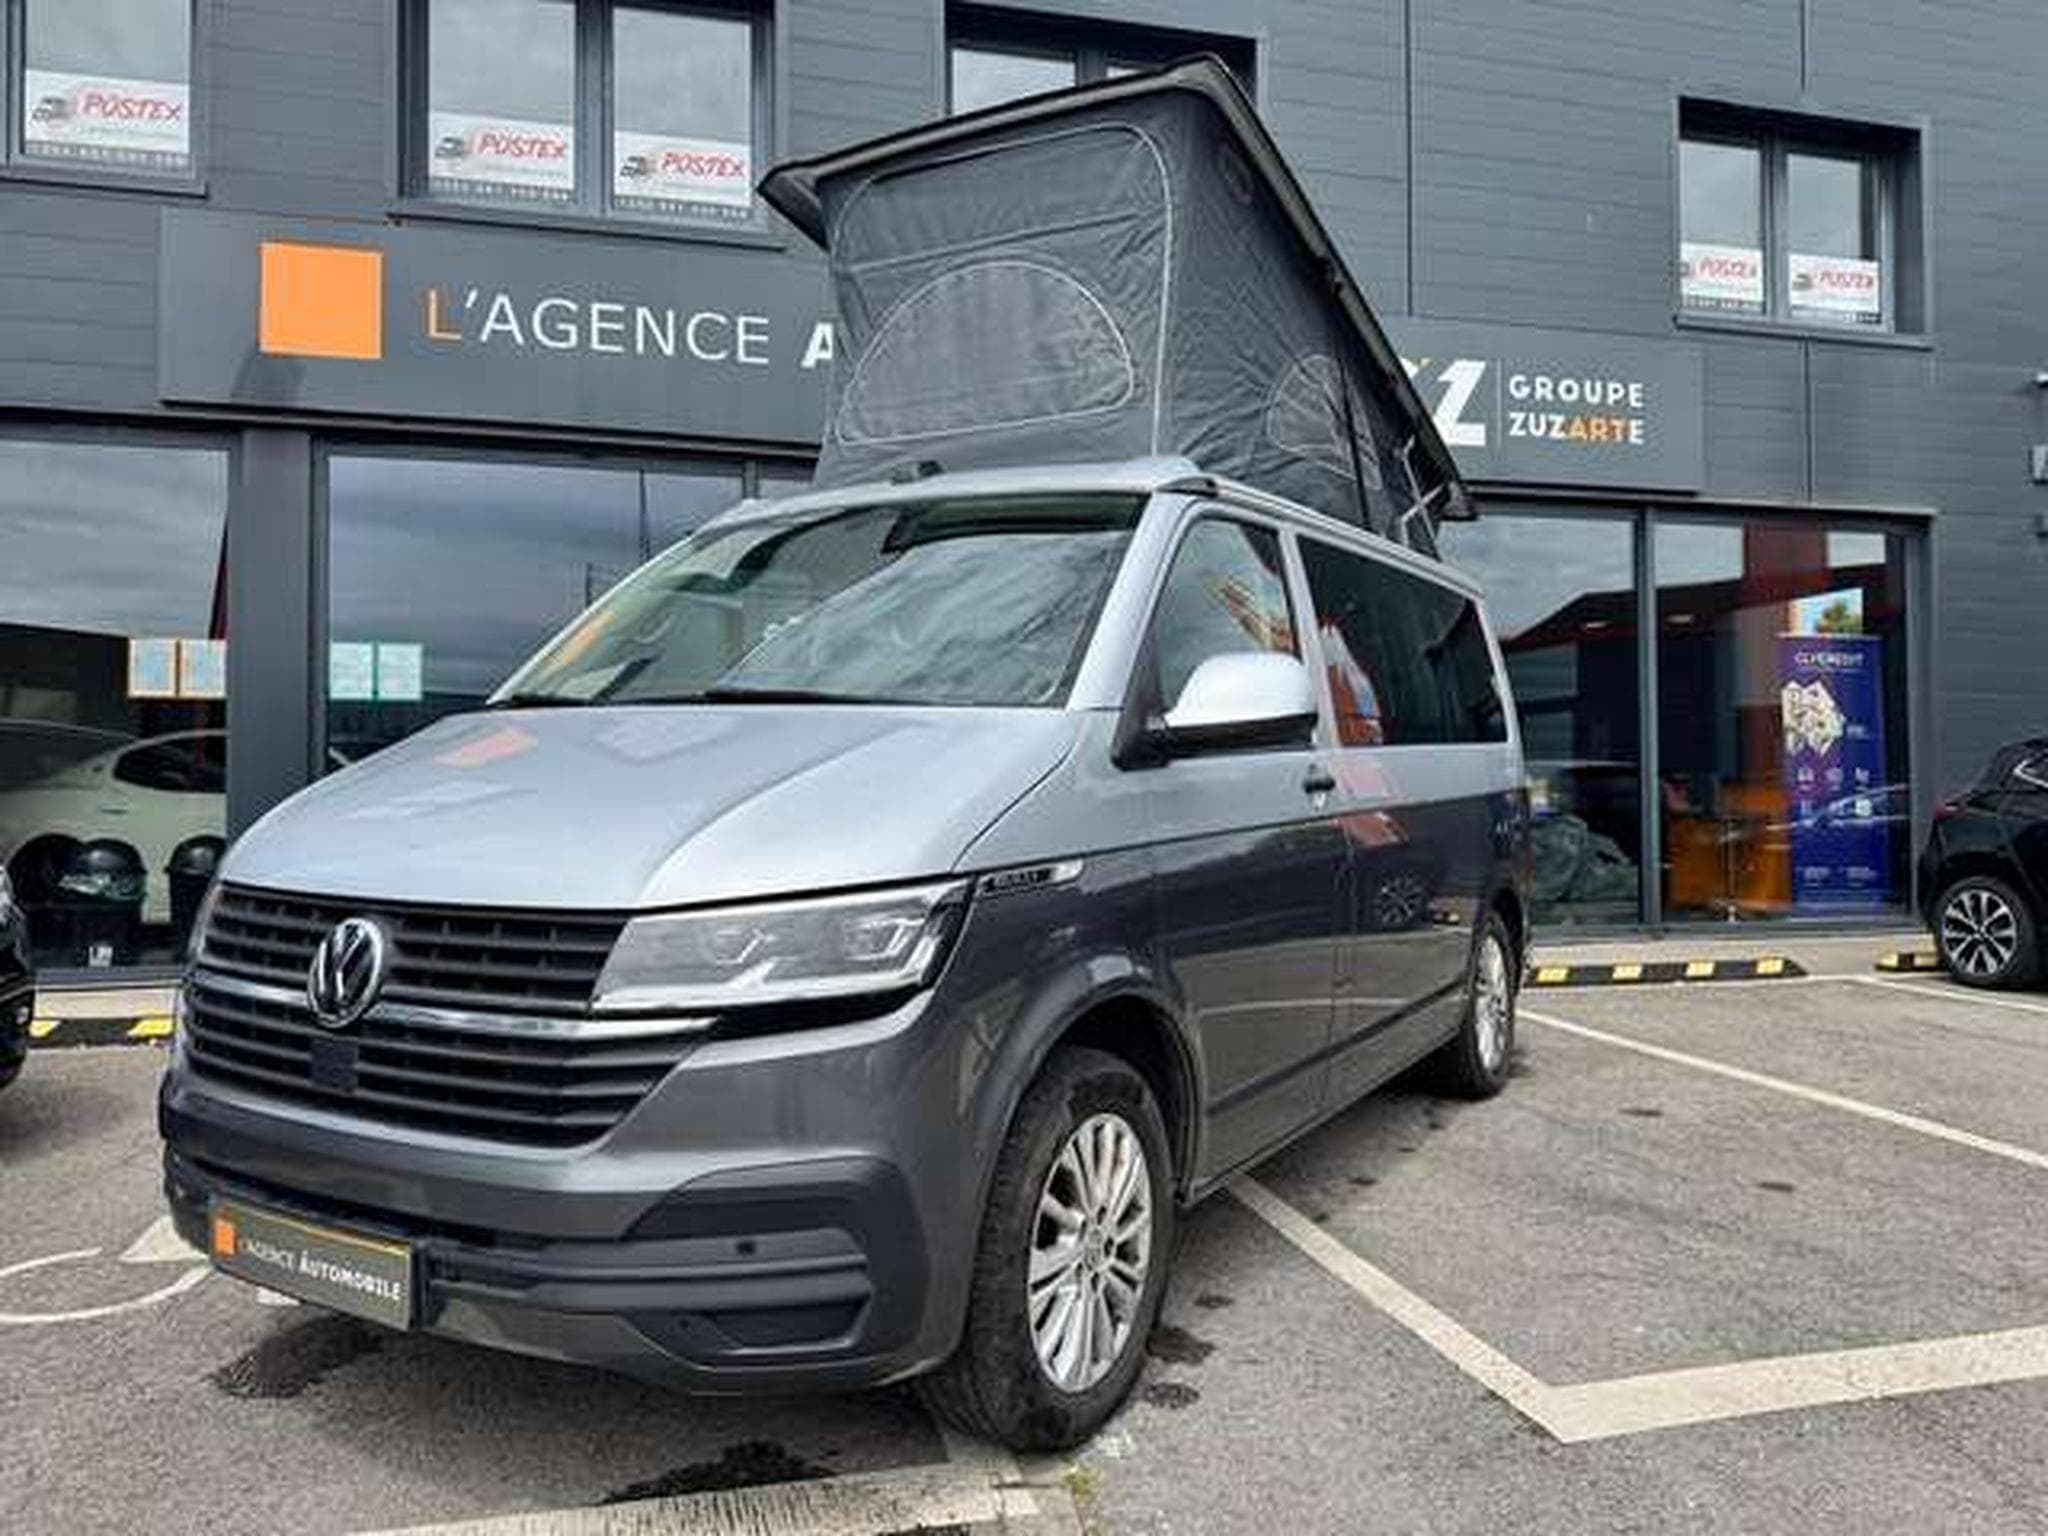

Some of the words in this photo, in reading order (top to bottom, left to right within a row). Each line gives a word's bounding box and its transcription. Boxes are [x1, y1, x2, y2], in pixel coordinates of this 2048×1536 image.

[83, 92, 181, 120] POSTEX
[479, 134, 565, 158] POSTEX
[662, 152, 745, 177] POSTEX
[426, 289, 770, 364] L'AGENCE
[1508, 374, 1645, 407] GROUPE
[1508, 412, 1645, 445] ZUZARTE
